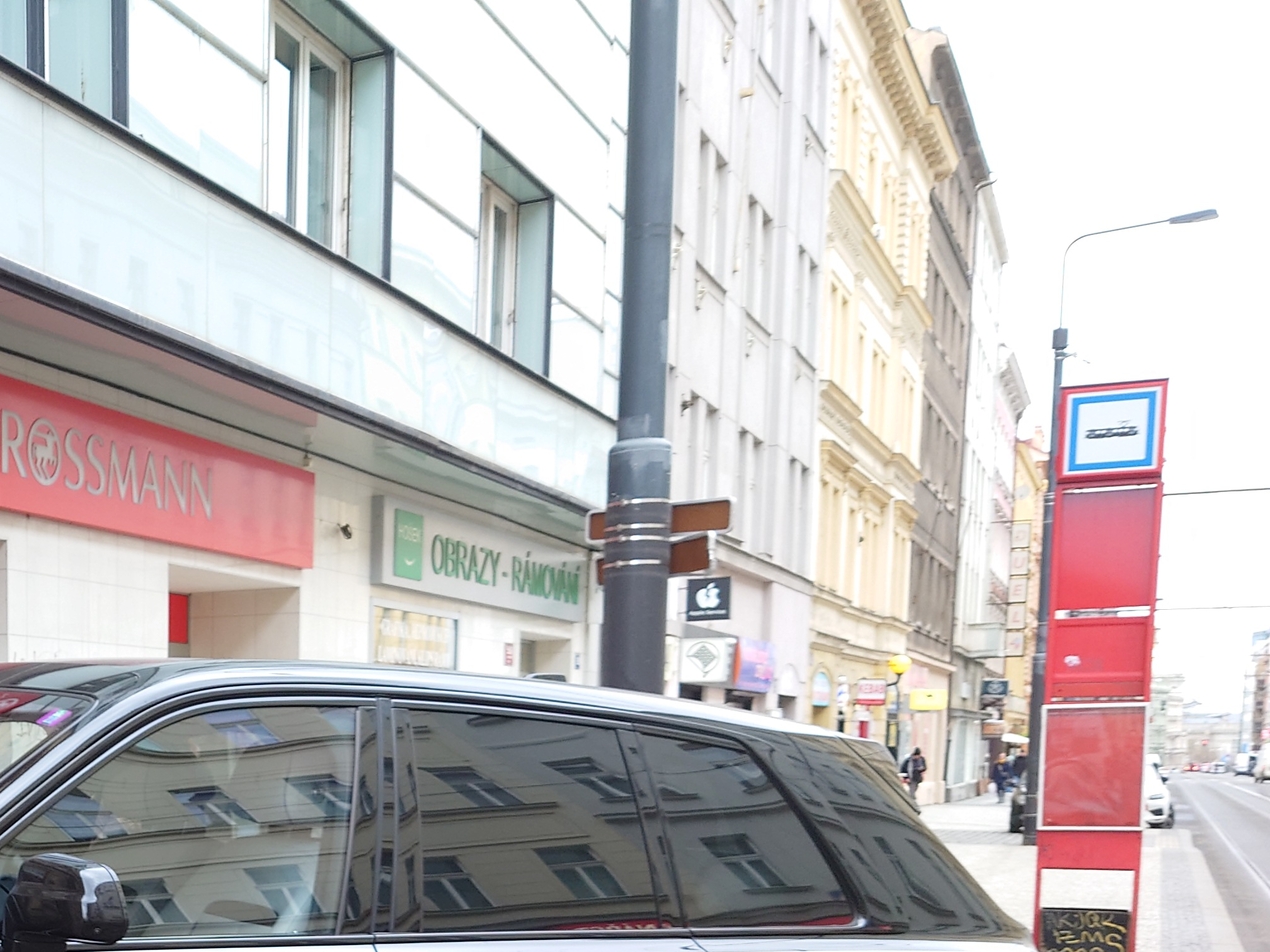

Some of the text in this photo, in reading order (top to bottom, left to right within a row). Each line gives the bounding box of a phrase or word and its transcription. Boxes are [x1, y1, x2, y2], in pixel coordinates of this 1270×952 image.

[0, 407, 213, 520] ROSSMANN
[431, 533, 501, 587] OBRAZY
[512, 550, 581, 605] RÁMOVÁNÍ
